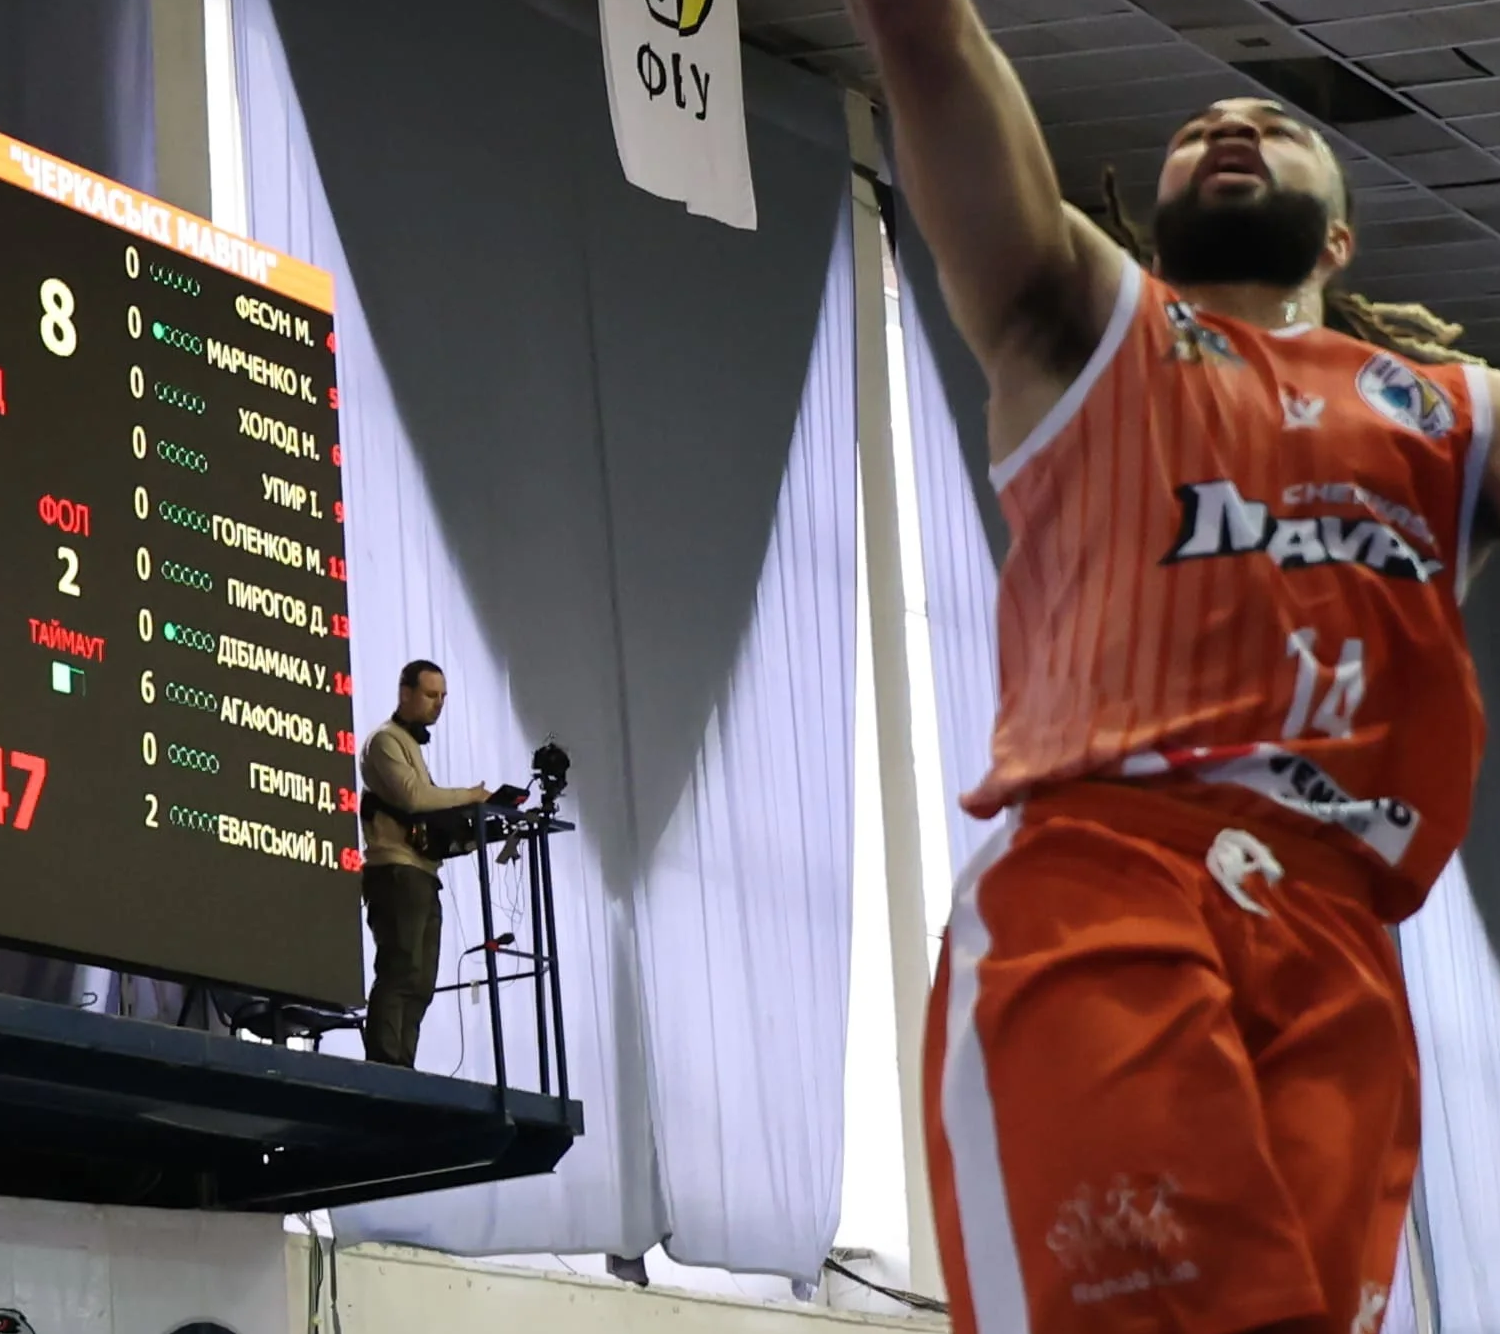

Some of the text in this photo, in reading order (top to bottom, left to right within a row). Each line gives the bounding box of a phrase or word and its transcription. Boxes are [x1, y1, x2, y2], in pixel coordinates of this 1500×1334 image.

[40, 278, 77, 357] 8
[126, 246, 315, 347] 0 ФЕСУН М.
[127, 305, 142, 339] 0
[207, 338, 297, 396] МАРЧЕНКО
[300, 374, 317, 405] К.
[130, 365, 144, 398] 0
[238, 407, 300, 458] ХОЛОД
[302, 432, 320, 461] Н.
[132, 425, 147, 459] 0
[262, 472, 307, 512] УПИР
[310, 491, 323, 519] І.
[39, 494, 90, 537] ФОЛ
[134, 486, 346, 581] 0 ГОЛЕНКОВ М. 11
[57, 546, 81, 597] 2
[136, 547, 151, 581] 0
[227, 578, 306, 626] ПИРОГОВ
[309, 605, 328, 638] Д.
[29, 618, 105, 663] ТАЙМАУТ
[138, 608, 153, 642] 0
[217, 635, 312, 687] ДІБІАМАКА
[314, 663, 331, 693] У.
[1284, 627, 1366, 739] 14
[140, 670, 156, 704] 6
[220, 695, 314, 745] АГАФОНОВ
[316, 723, 334, 751] А.
[142, 731, 157, 765] 0
[249, 762, 314, 805] ГЕМЛІН
[317, 781, 336, 815] Д.
[145, 793, 159, 828] 2
[320, 841, 338, 869] Л.
